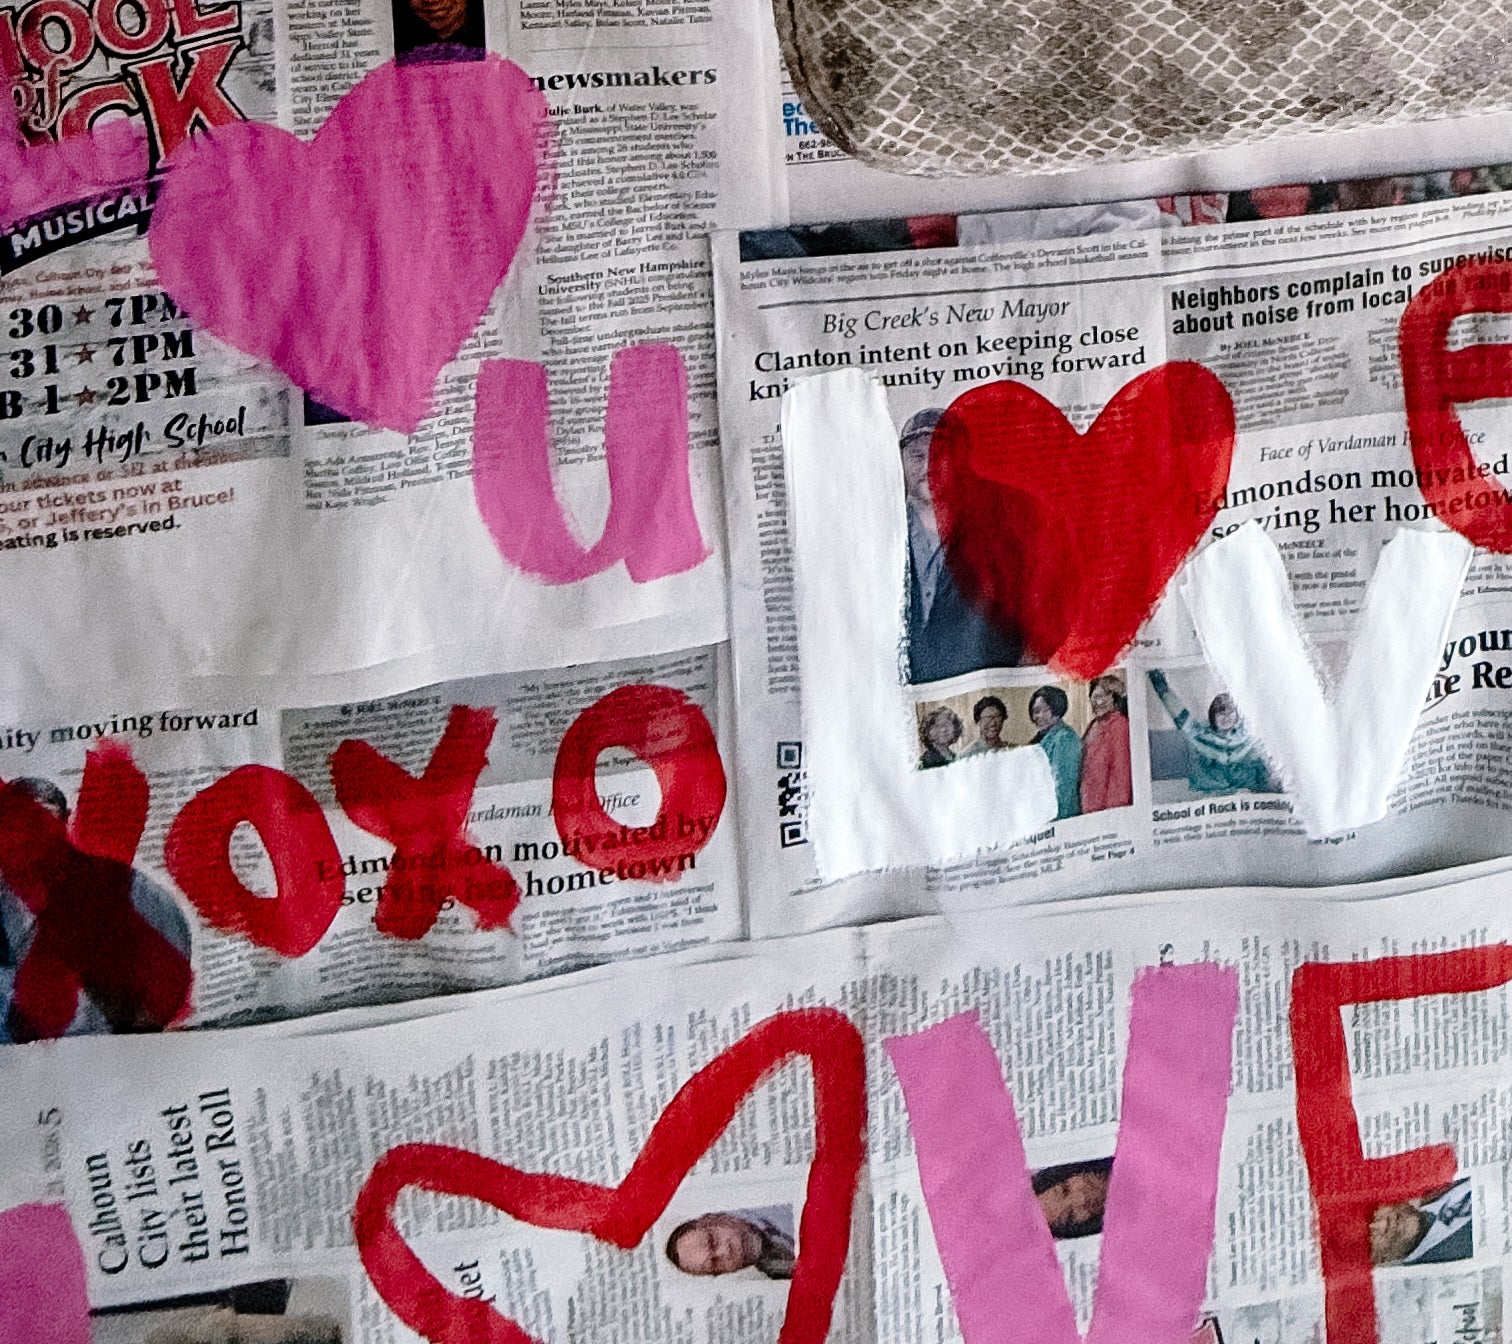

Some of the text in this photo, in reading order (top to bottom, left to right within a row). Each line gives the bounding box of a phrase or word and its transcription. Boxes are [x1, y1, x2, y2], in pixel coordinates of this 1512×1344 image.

[1171, 264, 1413, 311] Neighbors complain to
[1172, 284, 1412, 335] about noise from local
[821, 294, 1070, 340] Big Creek's New Mayor
[8, 330, 196, 378] 31 7PM
[754, 325, 1138, 372] Clanton intent on keeping close
[952, 345, 1146, 381] moving forward
[106, 367, 198, 406] 2PM
[20, 406, 247, 470] City High School
[161, 1103, 209, 1263] their latest
[200, 1087, 249, 1256] Honor Roll
[85, 1151, 128, 1275] Calhoun
[124, 1139, 180, 1269] City lists
